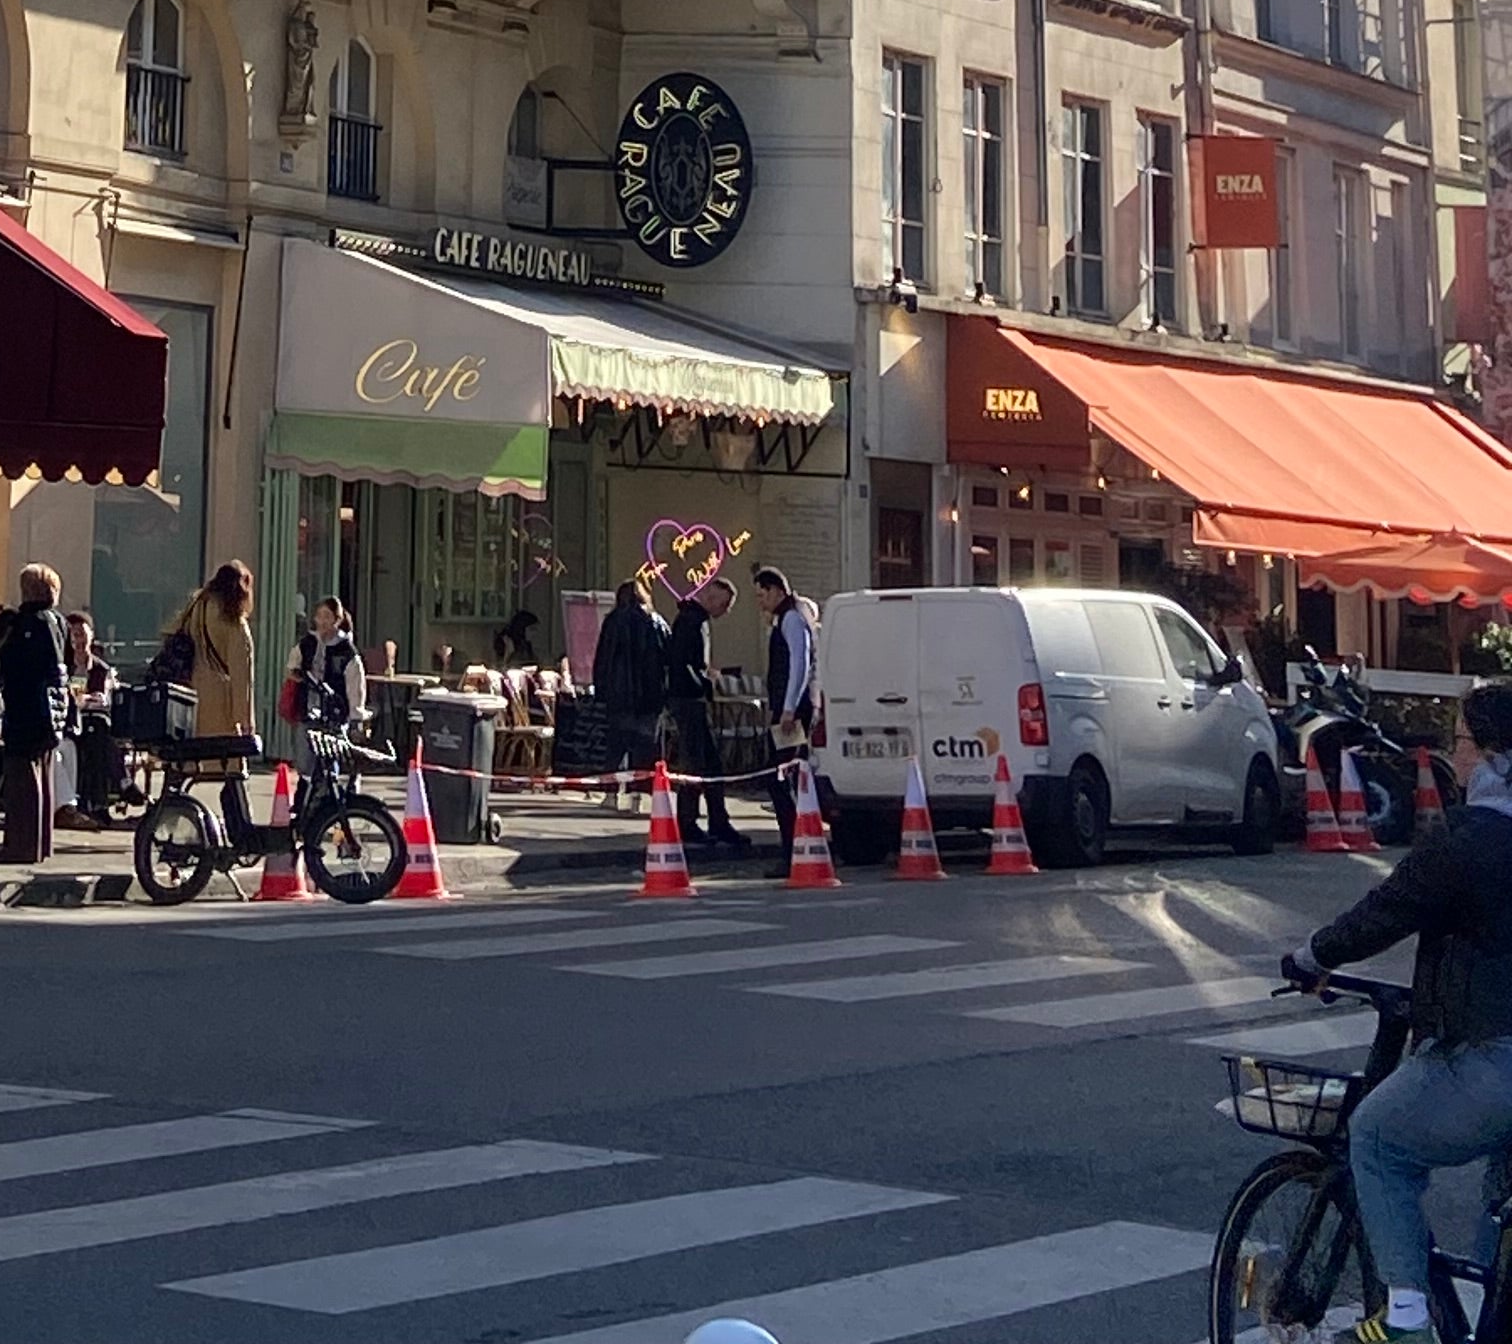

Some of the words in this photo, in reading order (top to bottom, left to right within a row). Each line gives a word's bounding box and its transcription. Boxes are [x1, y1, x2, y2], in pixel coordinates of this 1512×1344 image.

[633, 85, 730, 130] CAFE
[1215, 175, 1264, 193] ENZA
[434, 226, 484, 268] CAFE
[487, 236, 591, 286] RAGUENEAU
[355, 338, 487, 413] Café
[985, 388, 1040, 413] ENZA
[932, 735, 984, 758] ctm
